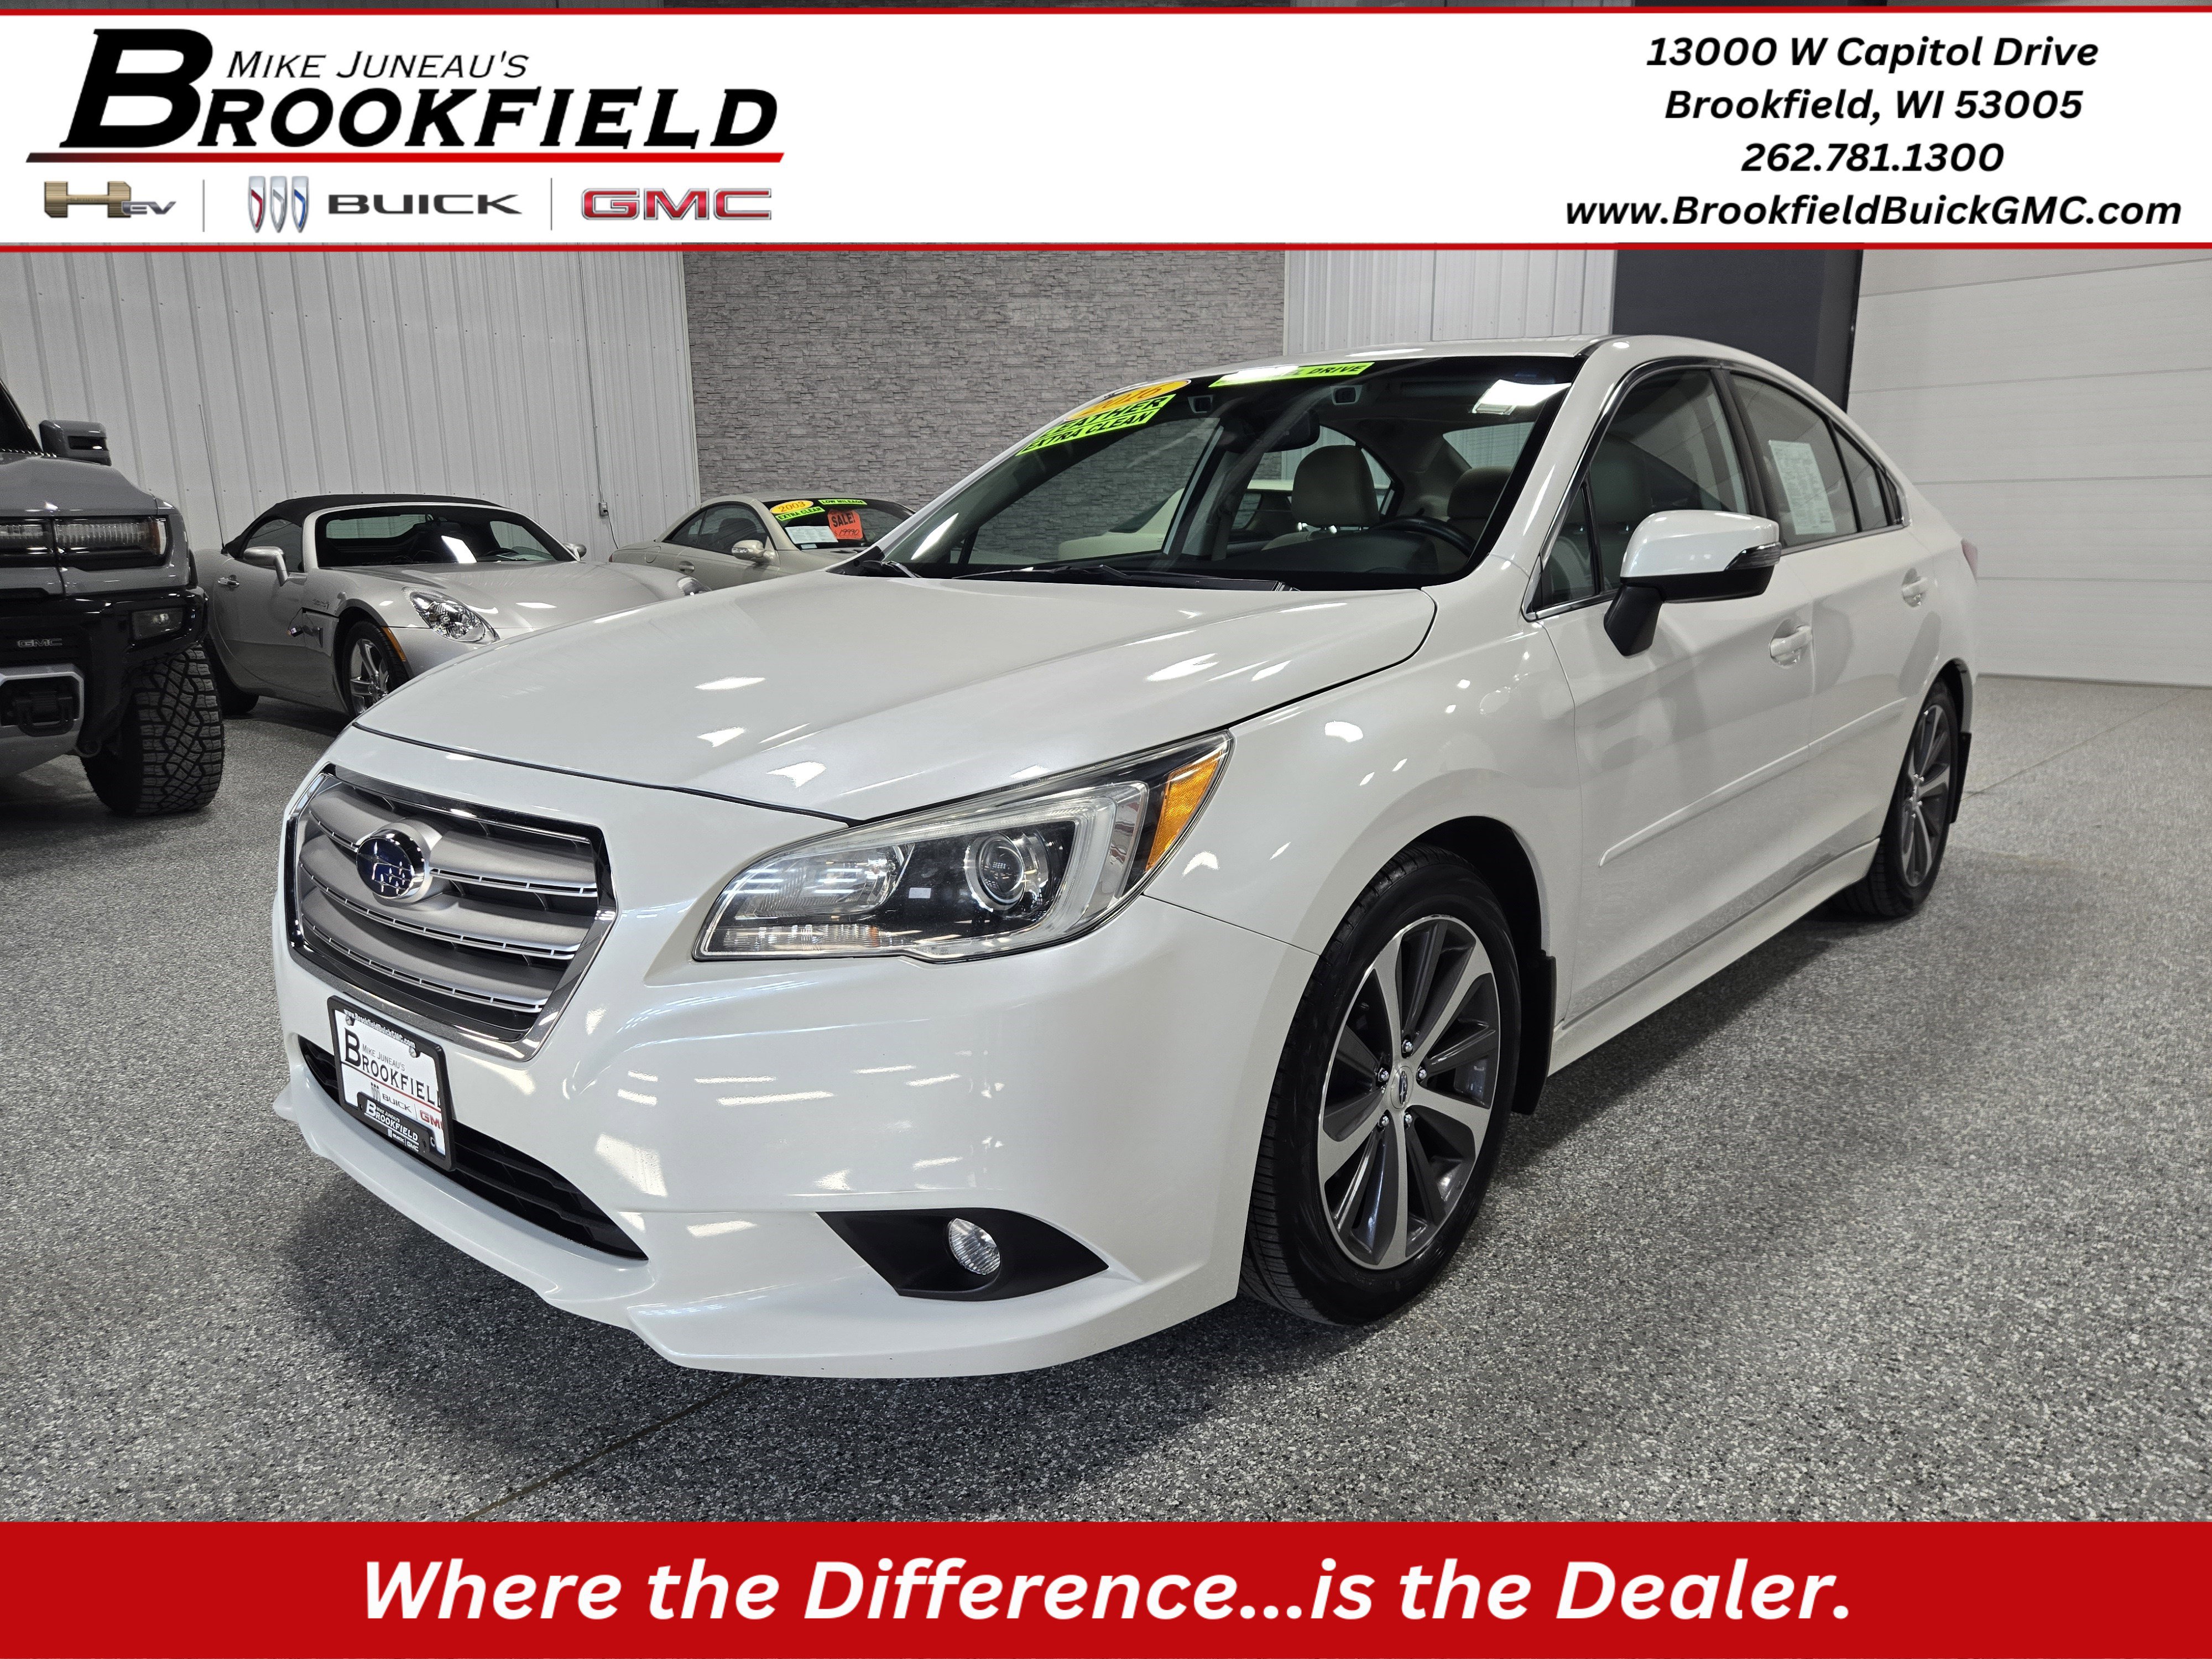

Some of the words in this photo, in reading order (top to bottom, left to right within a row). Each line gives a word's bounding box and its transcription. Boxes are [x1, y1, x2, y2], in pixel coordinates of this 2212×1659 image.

[1307, 365, 1366, 374] DRIVE
[1039, 397, 1168, 439] LEATHER
[1022, 428, 1083, 452] EXTRA
[1086, 411, 1154, 434] CLEAN
[779, 501, 806, 512] 2003
[832, 512, 856, 528] SALE!
[17, 638, 62, 648] GMC
[362, 1044, 375, 1057] MIKE
[377, 1052, 405, 1071] JUNEAU'S
[366, 1099, 419, 1141] BROOKFIELD
[382, 1093, 413, 1113] BUICK
[420, 1109, 442, 1129] GM
[407, 1141, 419, 1152] GMC
